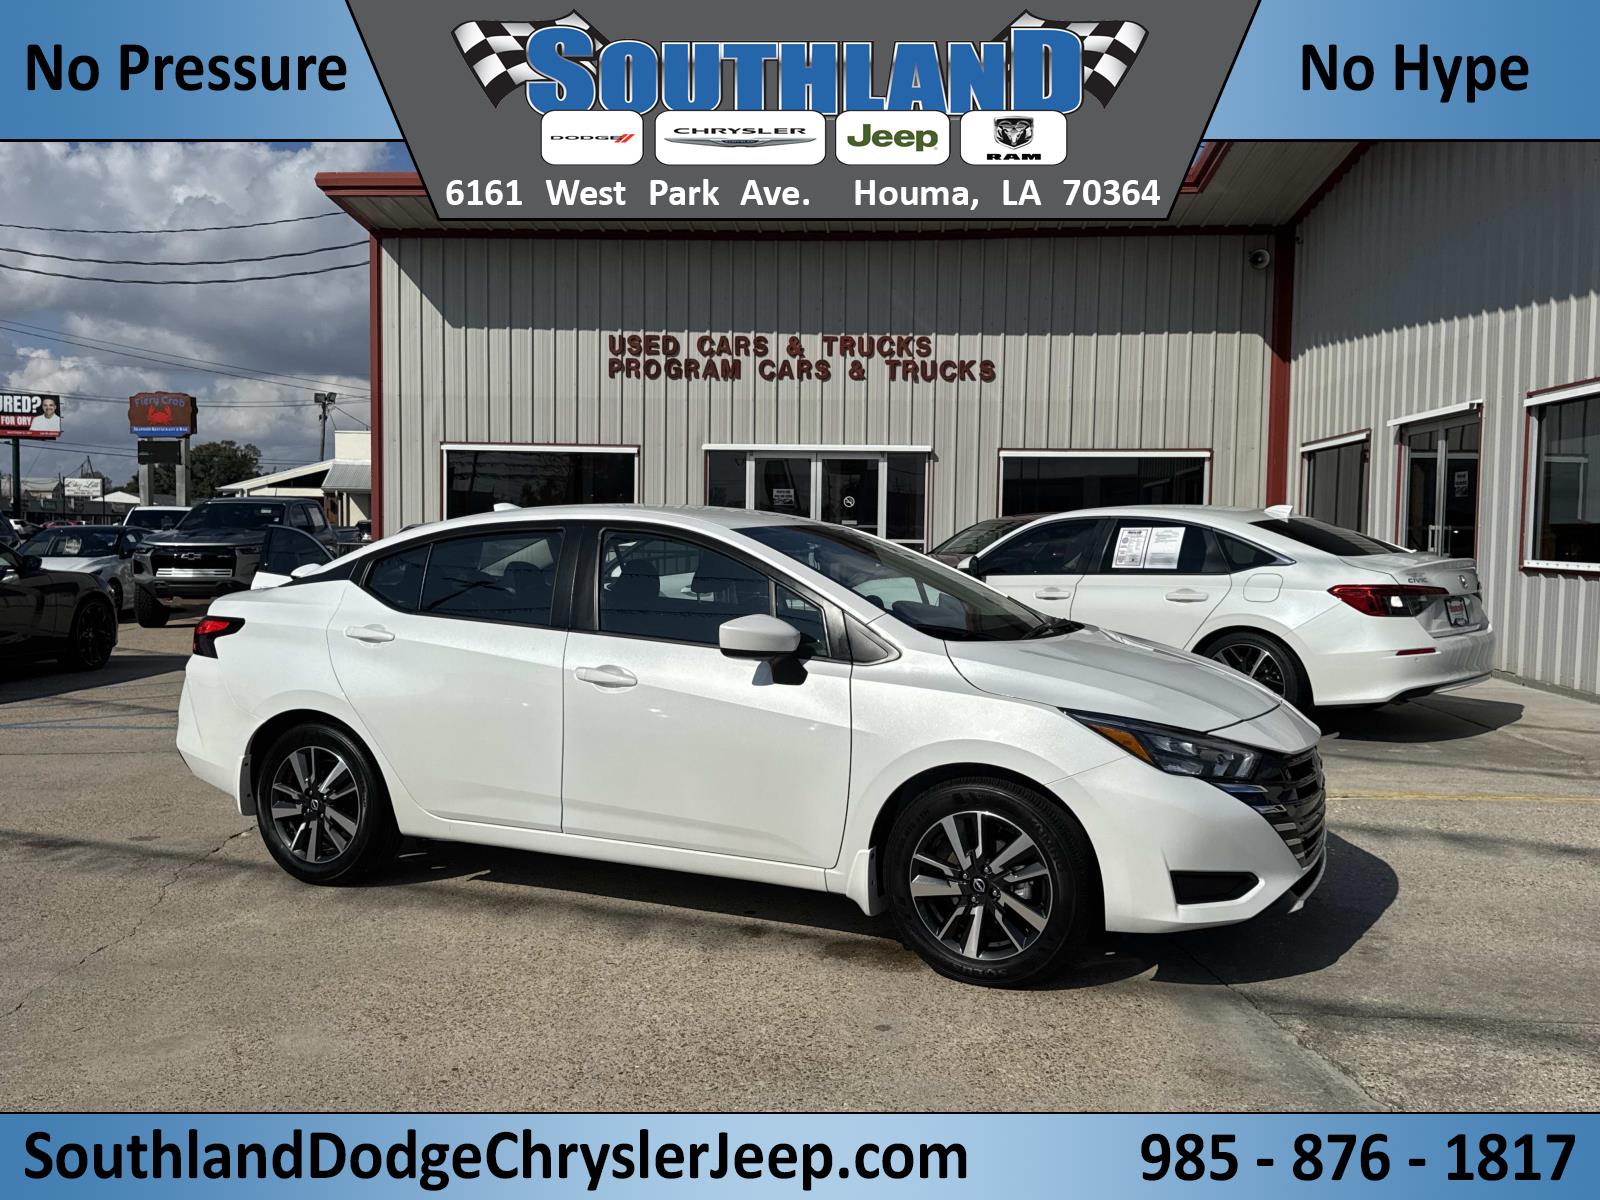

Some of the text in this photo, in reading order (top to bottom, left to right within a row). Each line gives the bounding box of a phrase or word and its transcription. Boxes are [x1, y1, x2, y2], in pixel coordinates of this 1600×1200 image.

[608, 334, 932, 358] USED CARS & TRUCKS
[608, 357, 997, 383] PROGRAM CARS & TRUCKS
[1, 415, 15, 425] FOR
